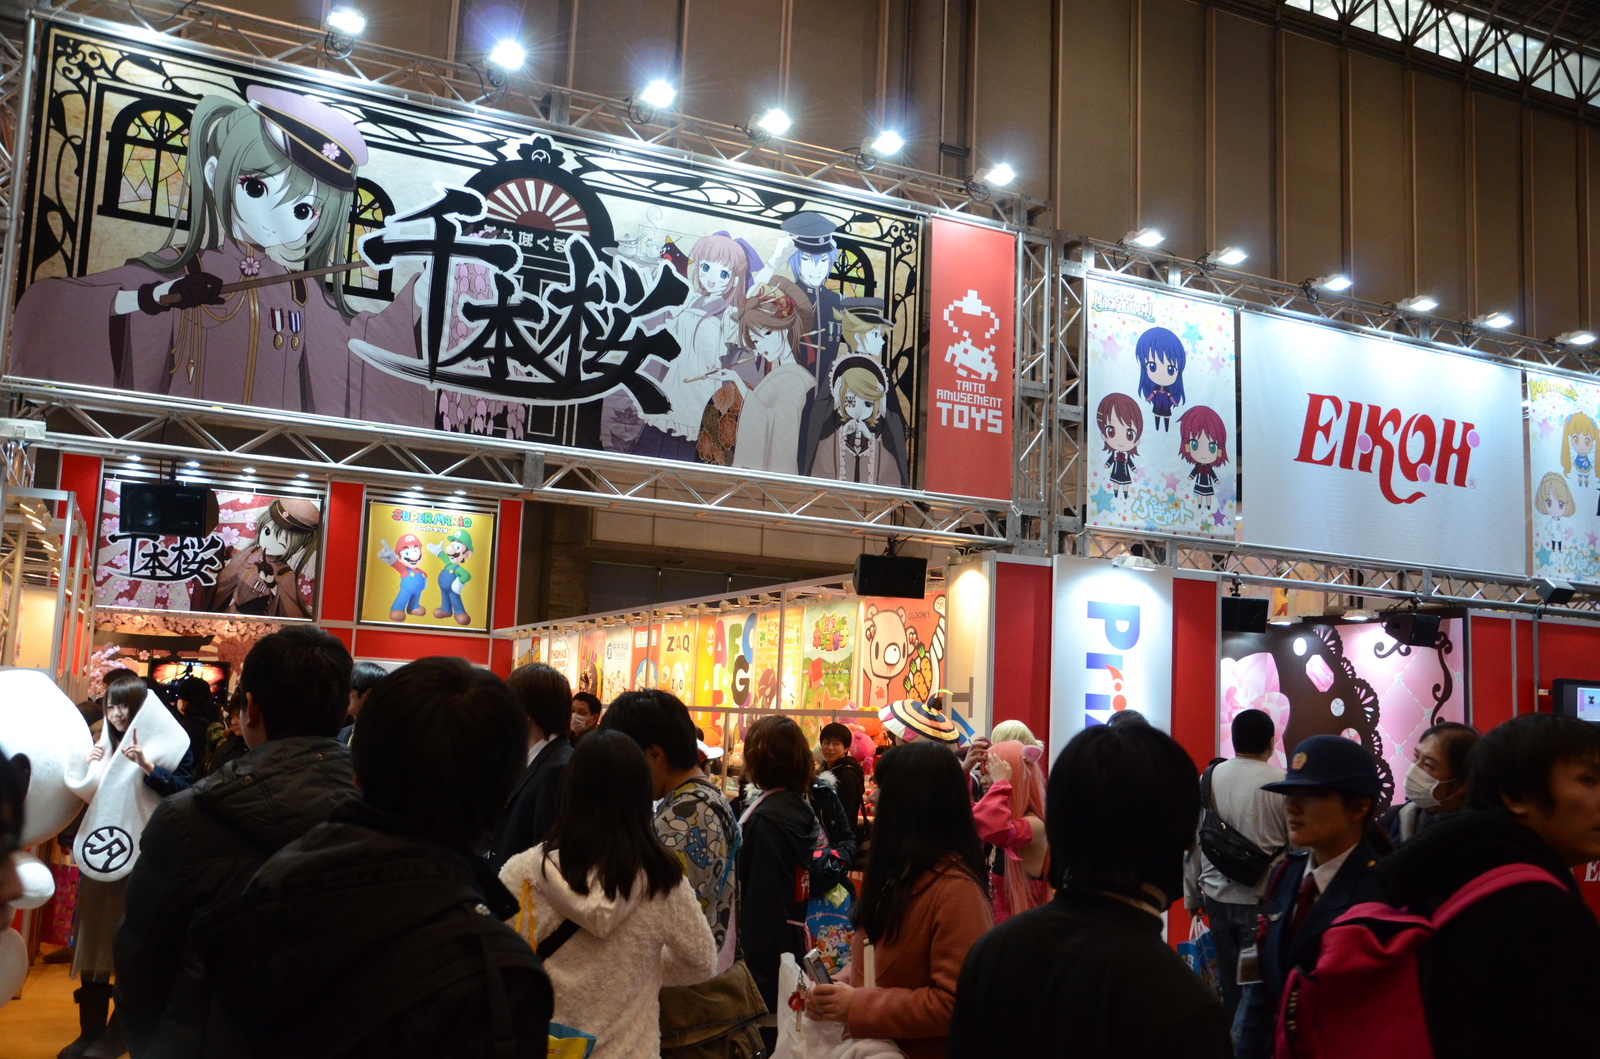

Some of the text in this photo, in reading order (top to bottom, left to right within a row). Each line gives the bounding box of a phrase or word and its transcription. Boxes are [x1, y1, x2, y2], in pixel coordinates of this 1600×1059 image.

[352, 184, 691, 415] 千本桜
[956, 380, 985, 394] TAITO
[936, 389, 1003, 409] AMUSEMENT
[936, 401, 1003, 434] TOYS
[1293, 392, 1480, 505] EIKOH
[391, 508, 473, 529] SUPER MARIO
[908, 610, 931, 620] GLOOMY
[666, 634, 690, 653] ZAQ
